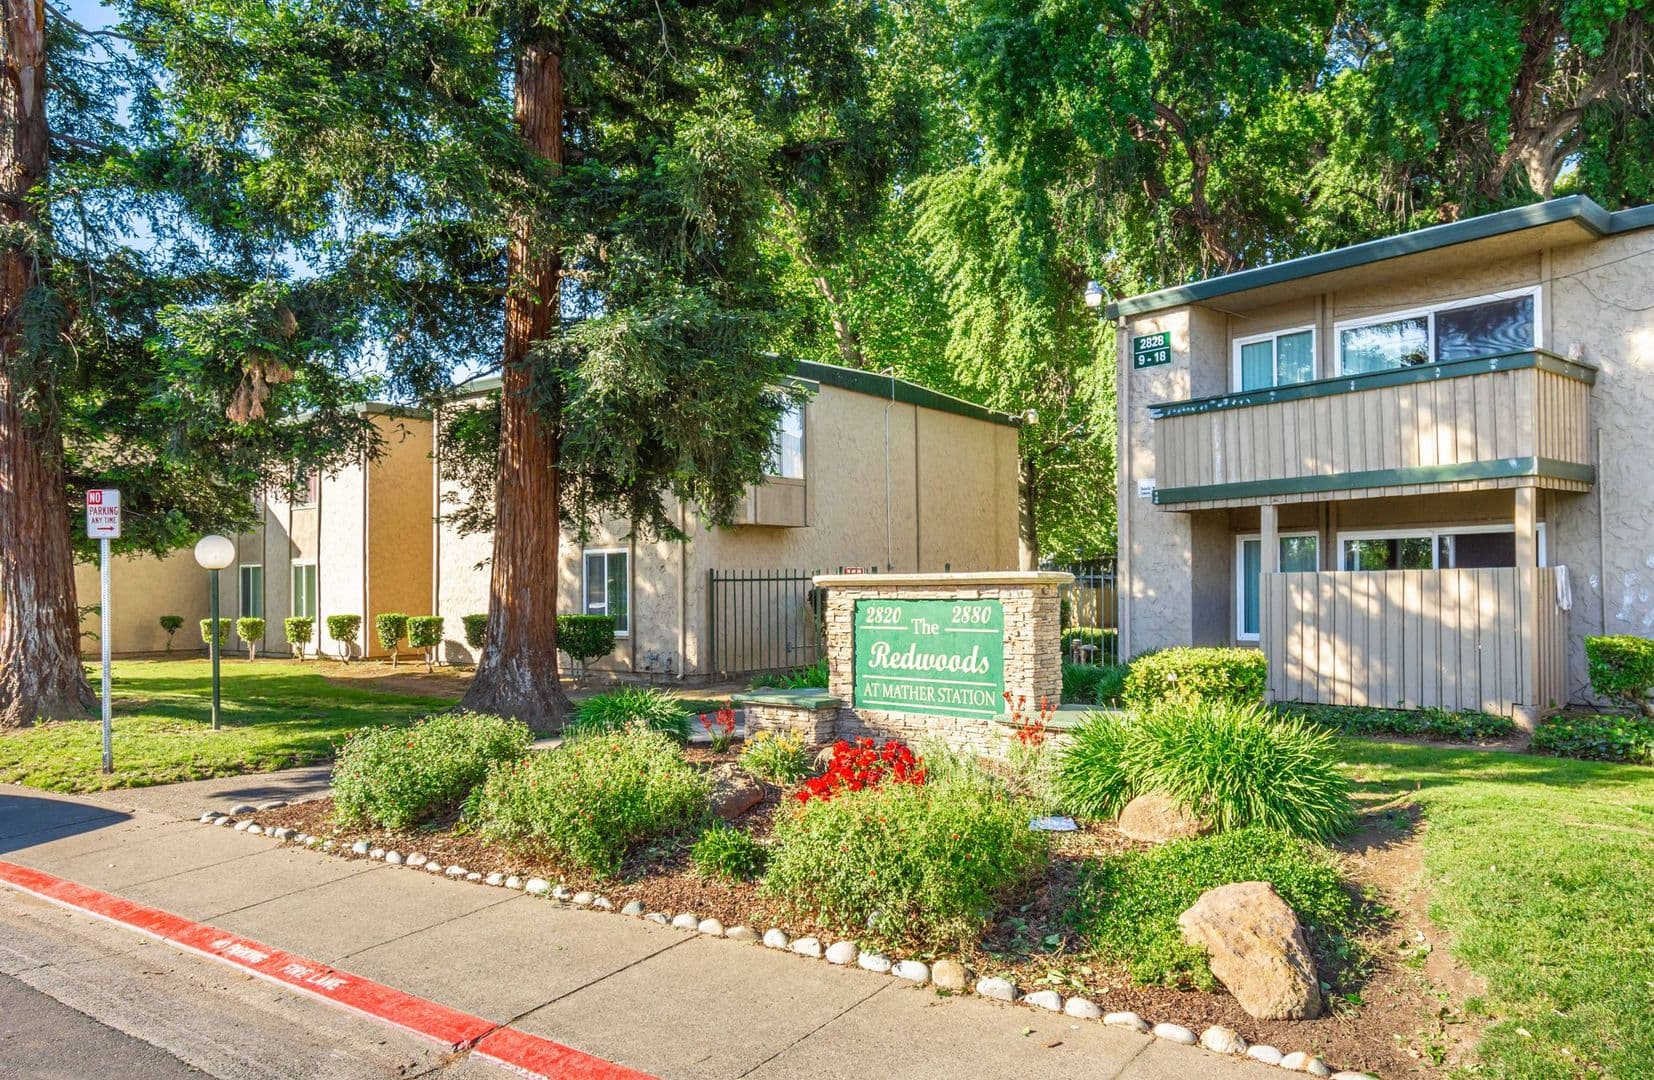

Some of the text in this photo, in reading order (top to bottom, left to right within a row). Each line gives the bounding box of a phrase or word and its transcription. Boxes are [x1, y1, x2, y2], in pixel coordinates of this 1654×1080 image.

[1140, 335, 1164, 349] 2828
[1138, 355, 1145, 365] 9
[1154, 351, 1166, 362] 18
[89, 492, 101, 503] NO
[89, 506, 119, 516] PARKING
[866, 606, 902, 624] 2820
[951, 605, 992, 624] 2880
[911, 618, 939, 635] The
[868, 641, 990, 674] Redwoods
[864, 682, 996, 706] AT MATHER STATION
[280, 963, 348, 991] FIRE LANE
